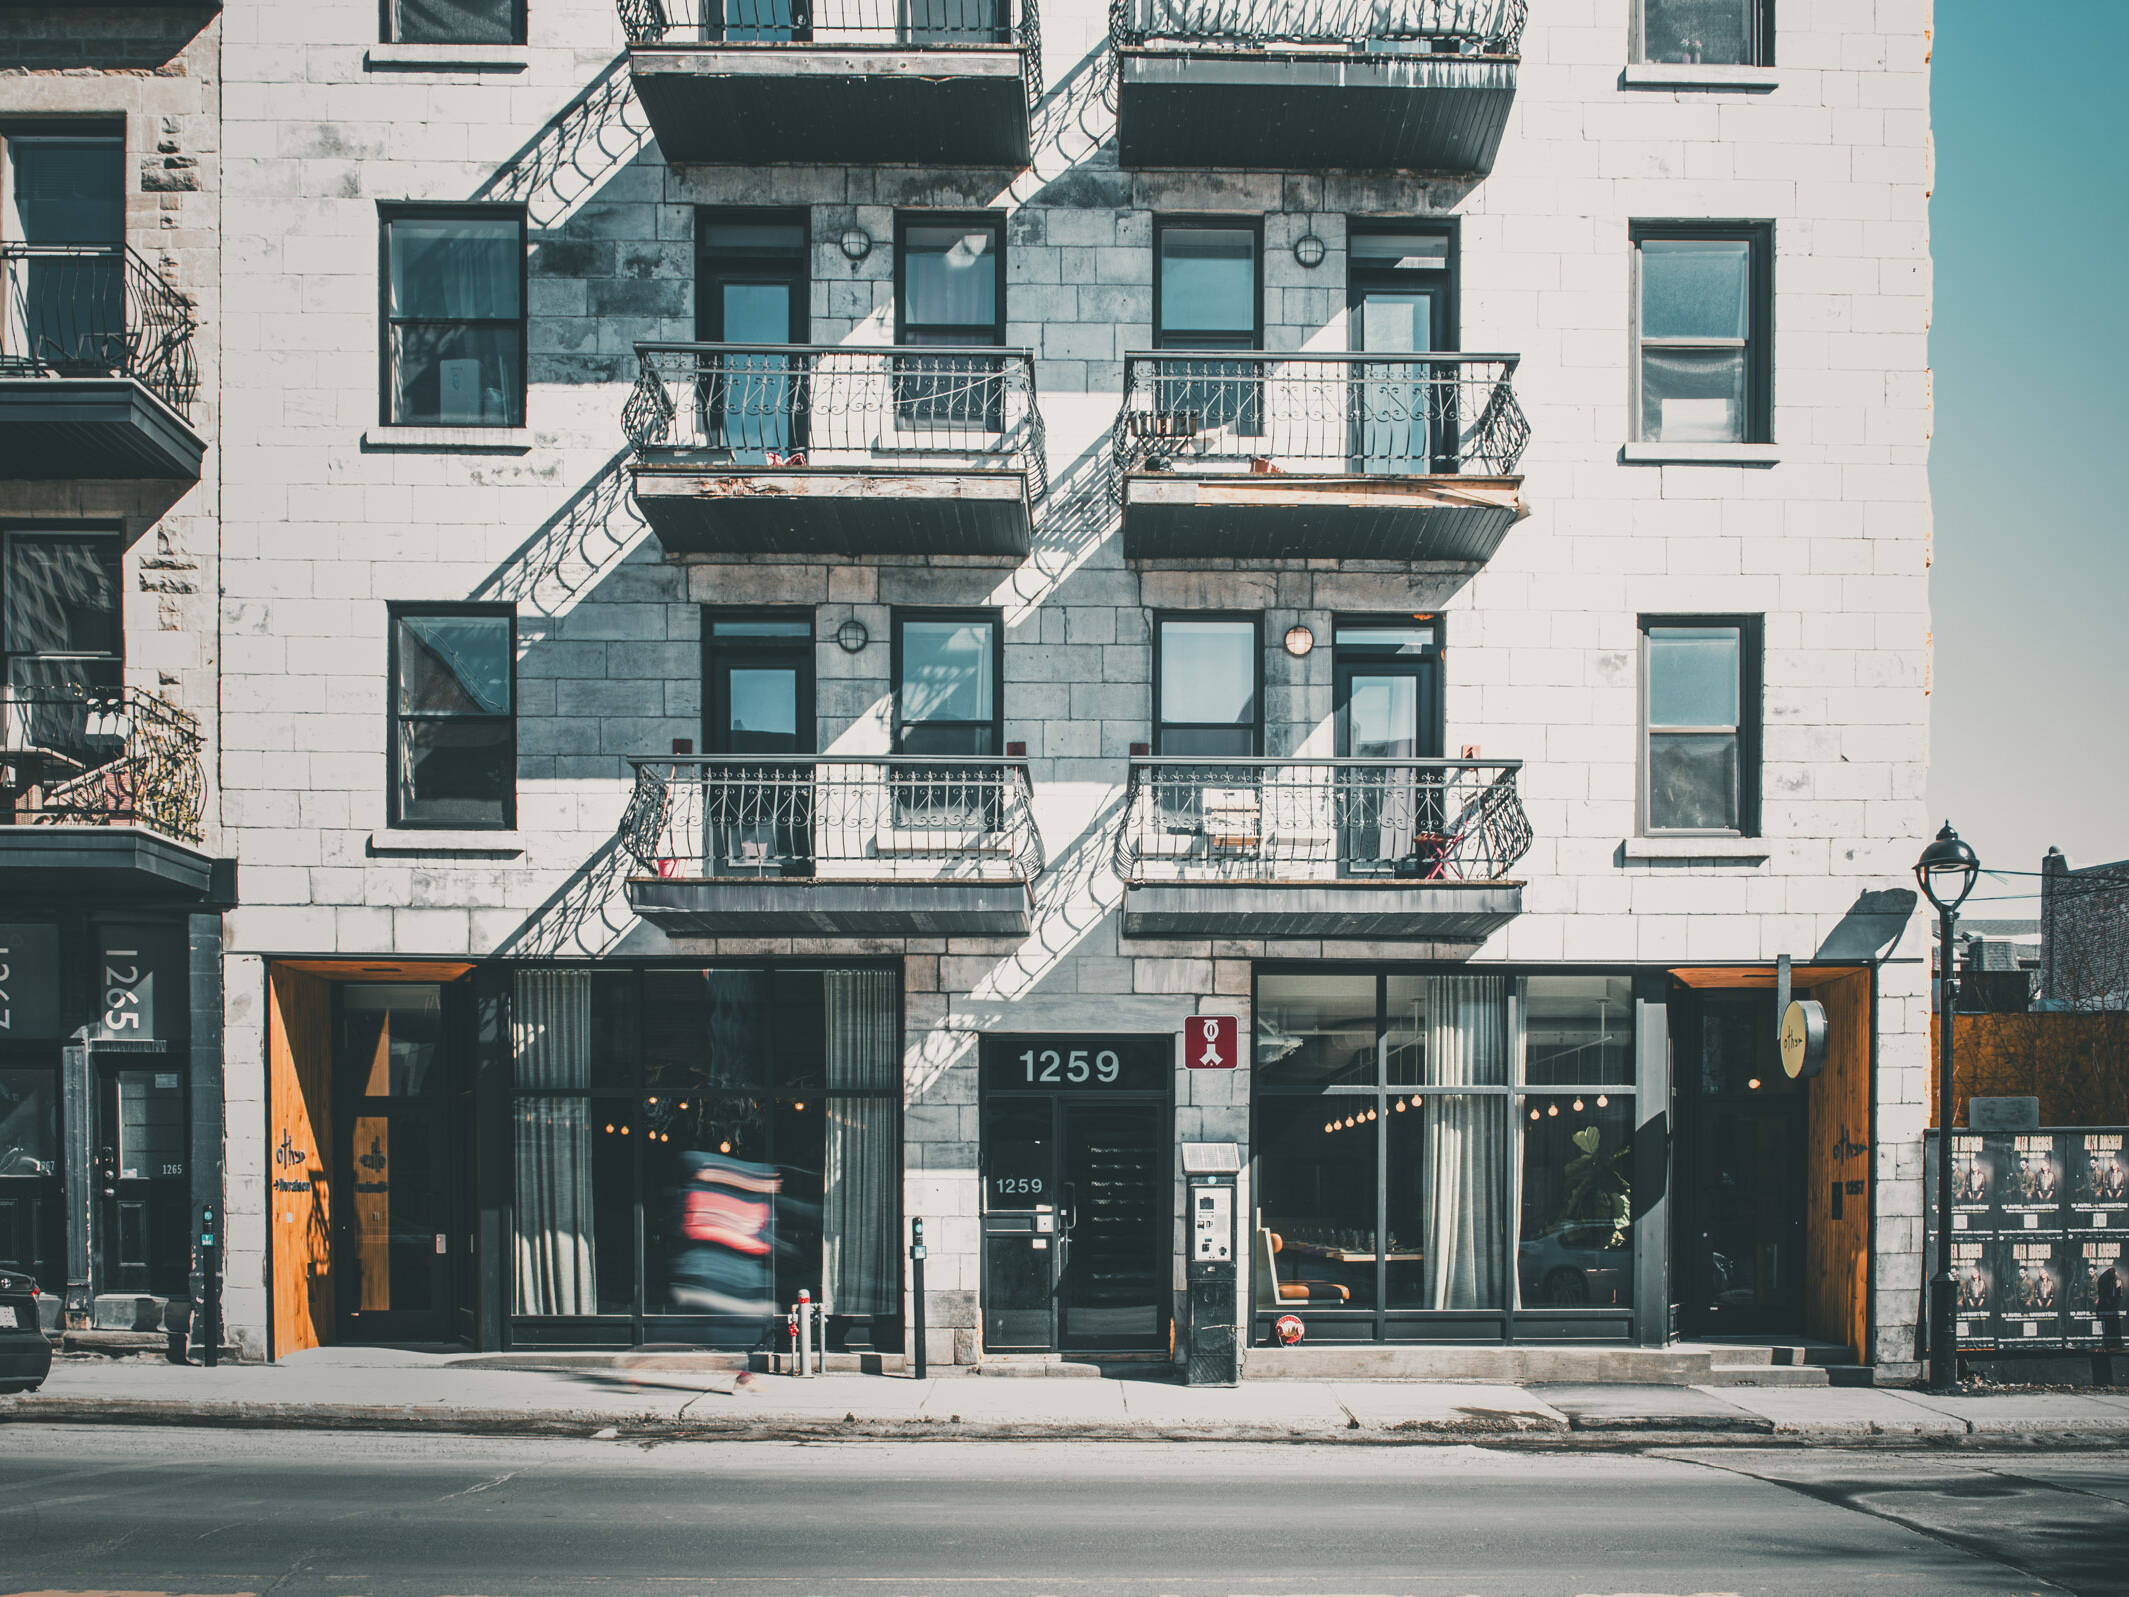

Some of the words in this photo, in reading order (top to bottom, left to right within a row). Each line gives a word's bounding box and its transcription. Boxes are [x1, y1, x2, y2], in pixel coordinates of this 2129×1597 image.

[105, 950, 139, 1030] 1265
[1019, 1050, 1119, 1083] 1259
[162, 1164, 182, 1175] 1265
[996, 1178, 1043, 1194] 1259
